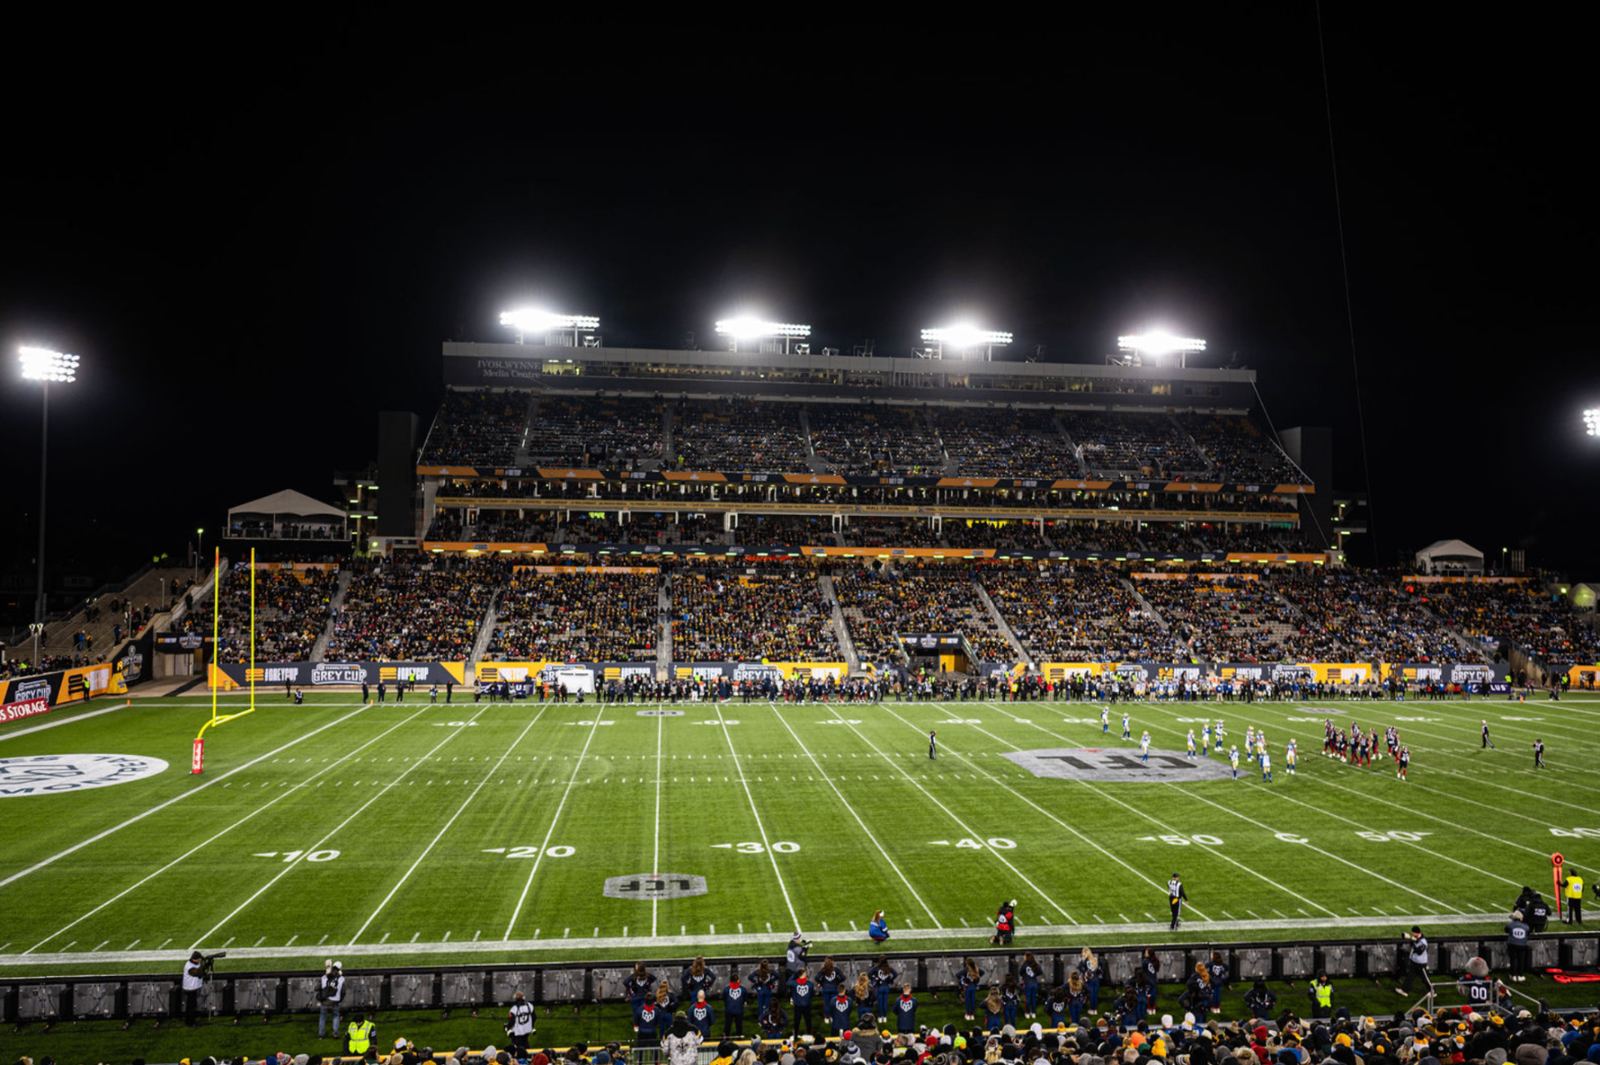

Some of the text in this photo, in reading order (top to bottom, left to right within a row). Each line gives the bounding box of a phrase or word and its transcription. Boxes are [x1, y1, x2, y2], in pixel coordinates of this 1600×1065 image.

[313, 670, 367, 683] GREY CUP
[7, 700, 47, 719] STORAGE
[1157, 834, 1224, 847] 50
[1355, 831, 1423, 842] 50
[736, 841, 801, 853] 30
[955, 837, 1018, 850] 40
[280, 849, 342, 863] 10
[505, 845, 576, 859] 20
[1471, 986, 1487, 1000] 00
